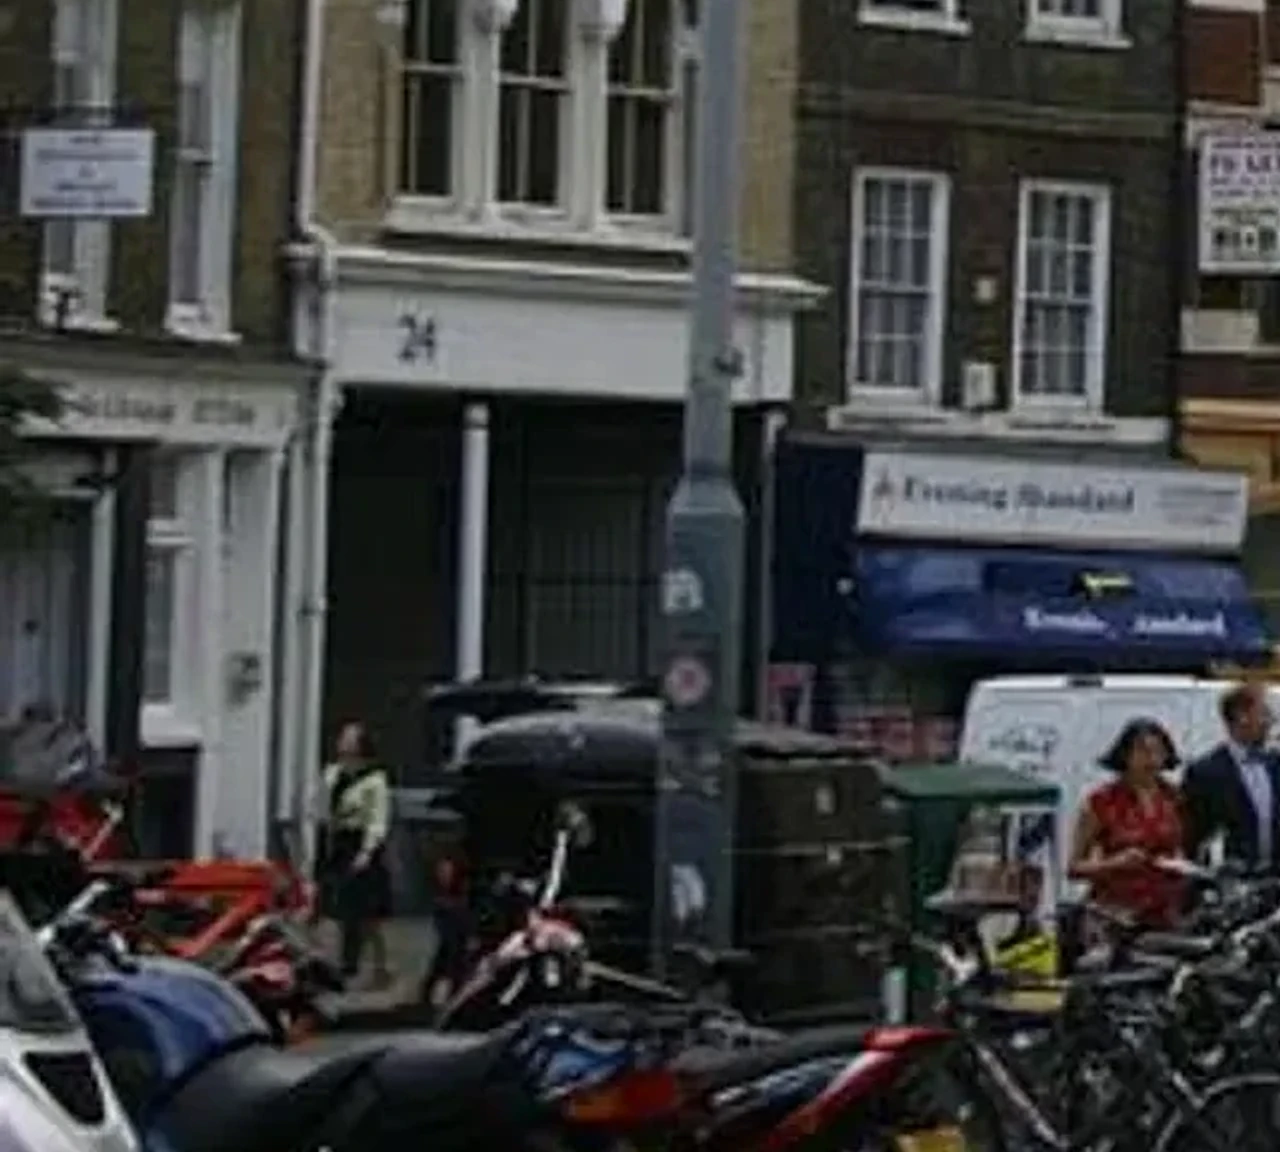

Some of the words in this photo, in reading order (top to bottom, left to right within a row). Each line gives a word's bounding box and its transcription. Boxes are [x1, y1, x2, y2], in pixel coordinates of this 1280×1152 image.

[1210, 155, 1237, 176] TO
[398, 313, 436, 364] 24
[904, 474, 1008, 512] Evening
[1013, 479, 1135, 515] Standard
